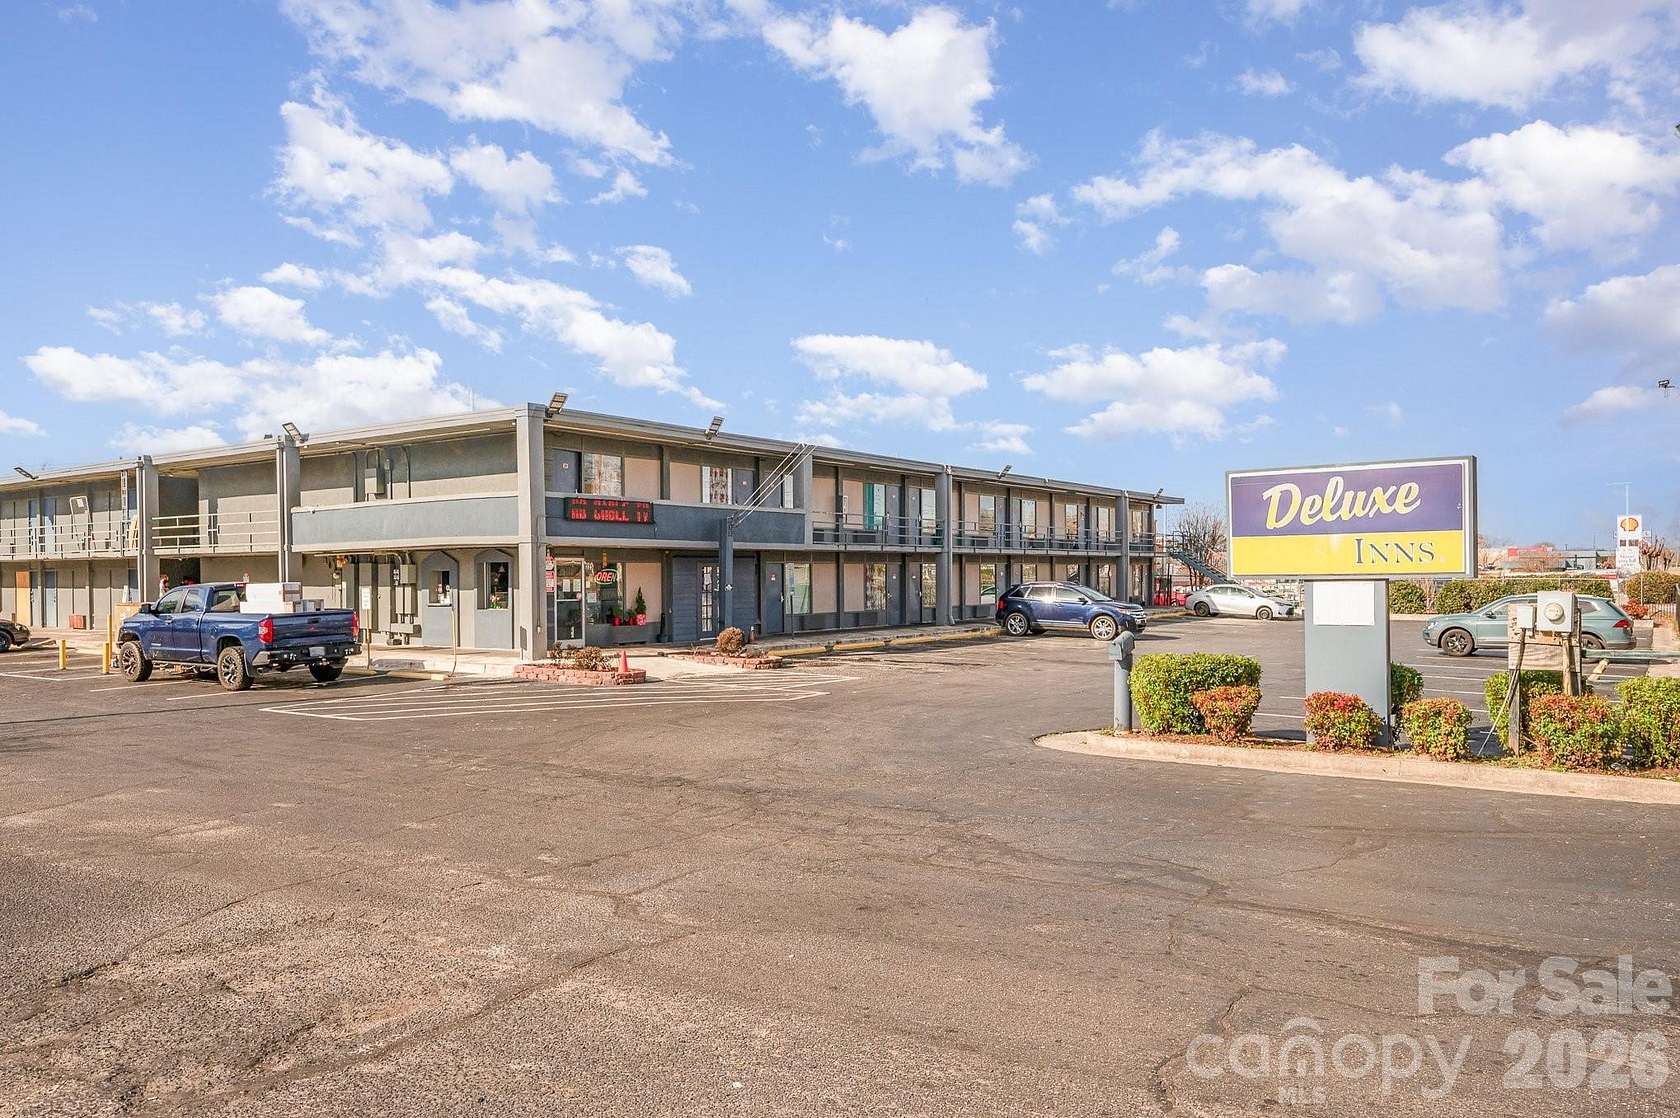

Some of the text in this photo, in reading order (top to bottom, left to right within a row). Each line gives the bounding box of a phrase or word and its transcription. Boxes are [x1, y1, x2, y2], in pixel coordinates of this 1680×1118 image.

[1263, 476, 1421, 529] Deluxe
[1355, 538, 1435, 564] INNS
[596, 571, 617, 583] OPEN
